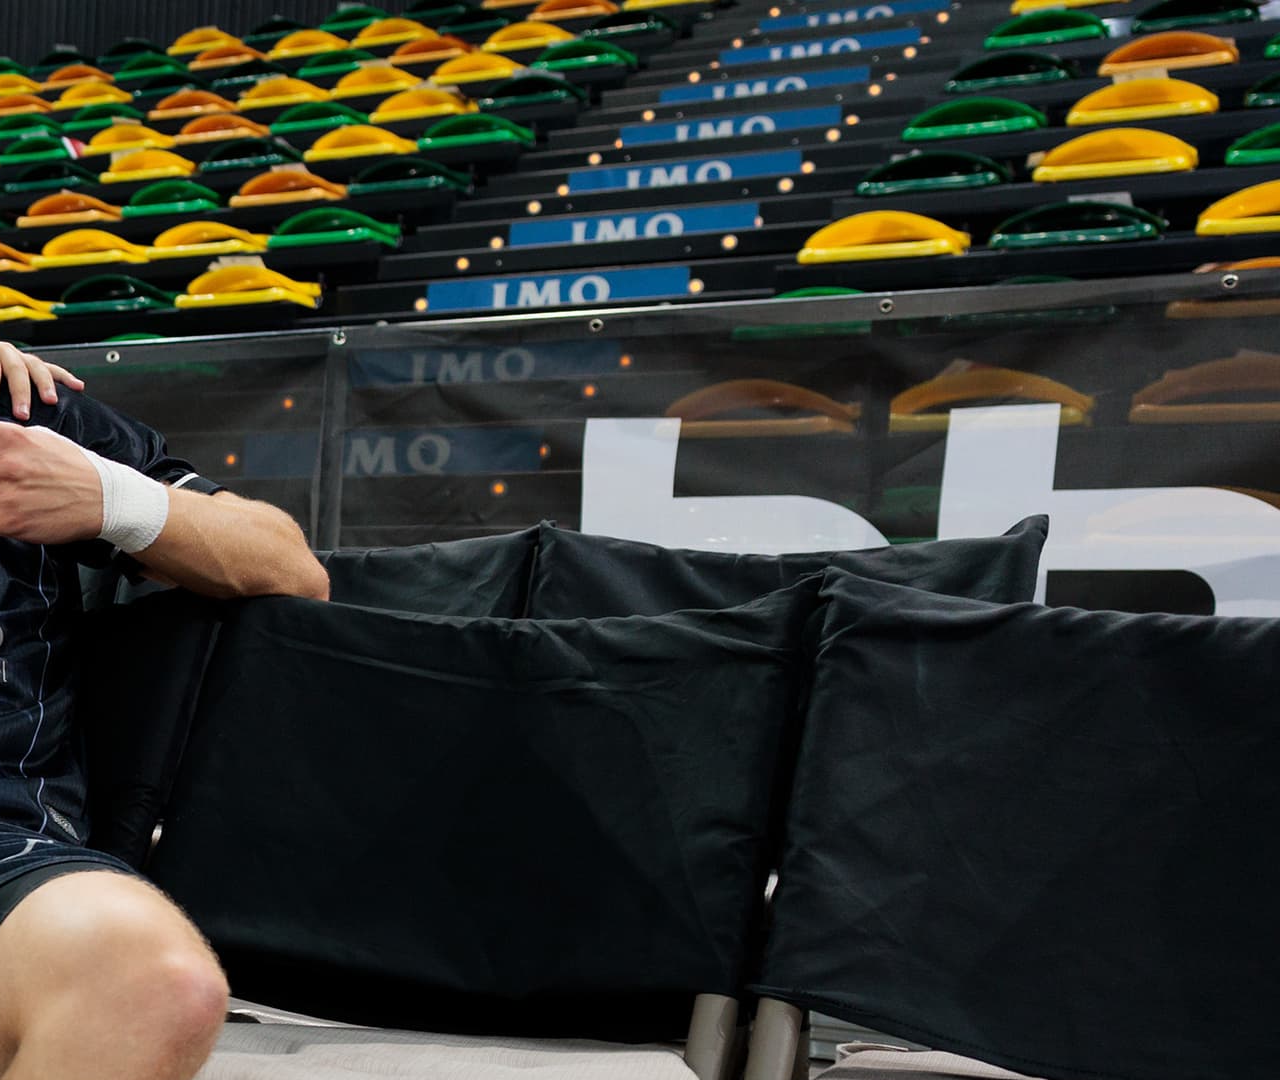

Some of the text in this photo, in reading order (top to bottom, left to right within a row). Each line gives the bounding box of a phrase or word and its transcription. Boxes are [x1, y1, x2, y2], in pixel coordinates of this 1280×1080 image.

[571, 212, 684, 245] IMO
[492, 275, 611, 309] IMO
[345, 433, 451, 475] MO
